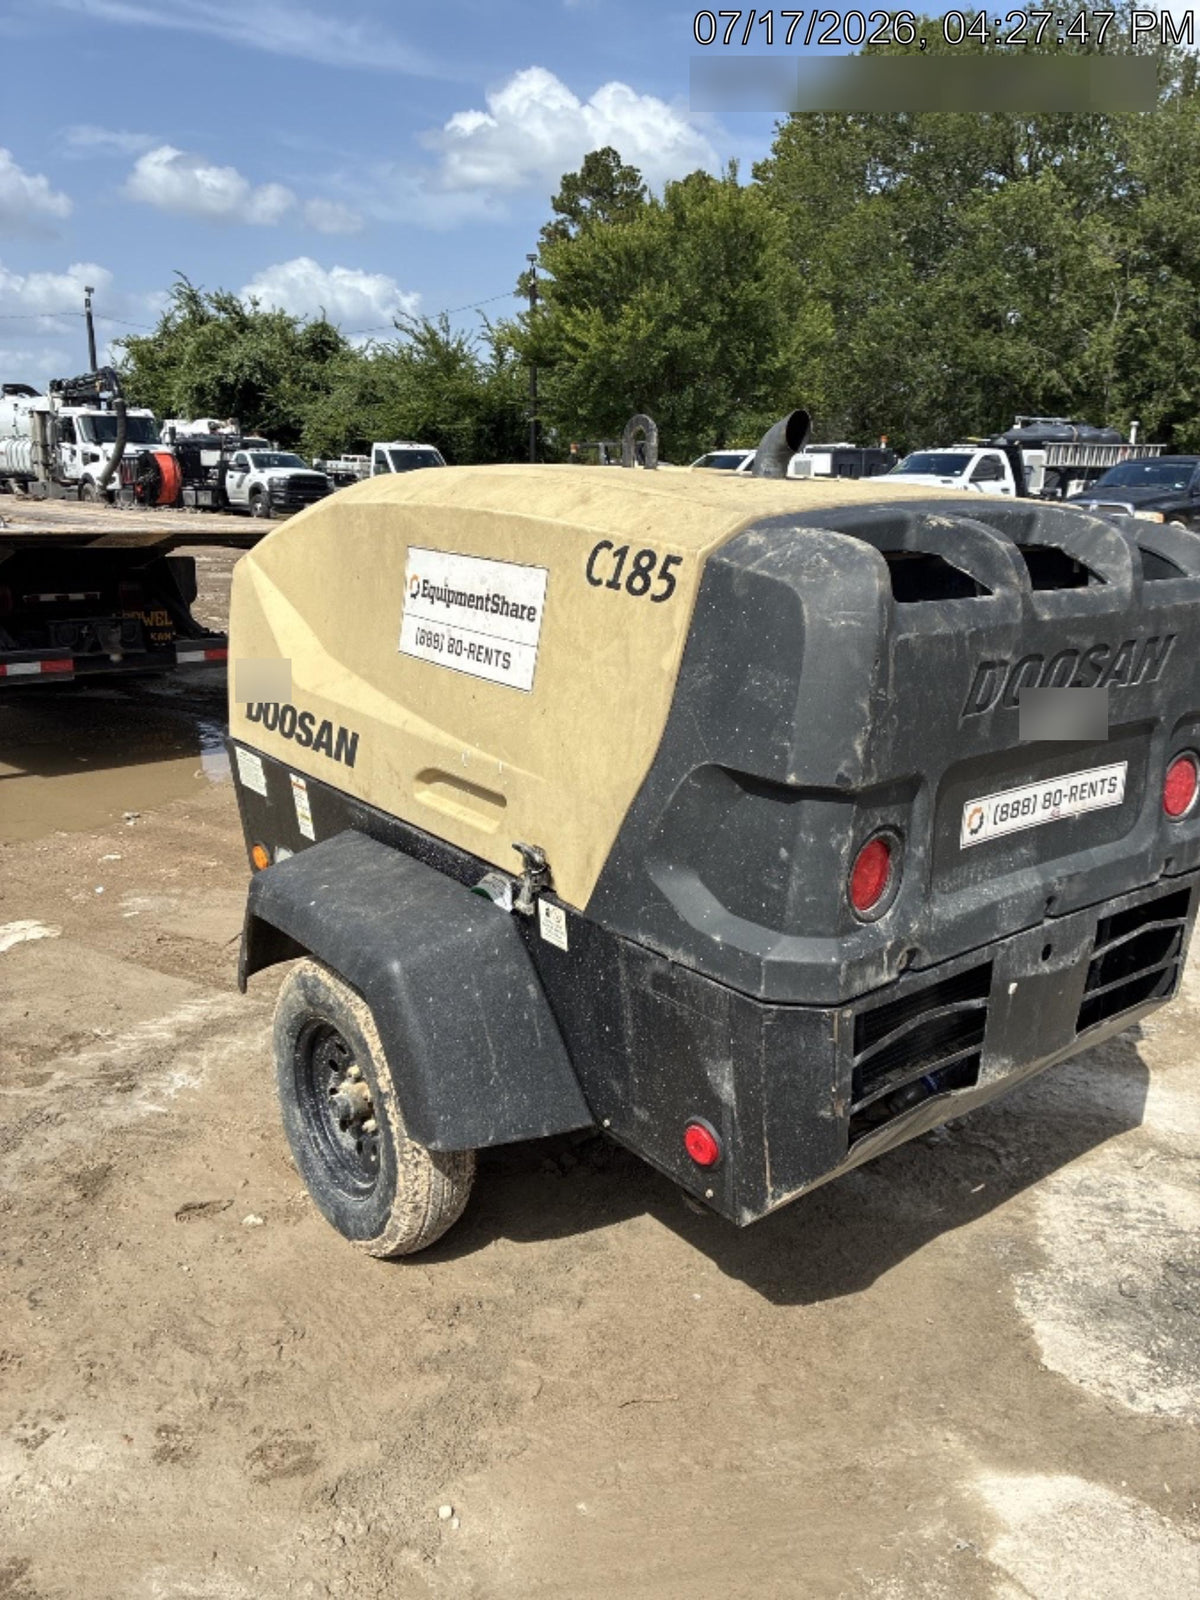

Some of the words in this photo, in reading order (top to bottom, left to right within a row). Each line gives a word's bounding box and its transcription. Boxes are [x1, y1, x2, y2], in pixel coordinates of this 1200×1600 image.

[586, 540, 683, 602] C185
[421, 579, 537, 622] EquipmentShare
[959, 634, 1177, 720] DOOSAN
[993, 801, 1037, 825] (888)
[1041, 776, 1118, 810] 80-RENTS
